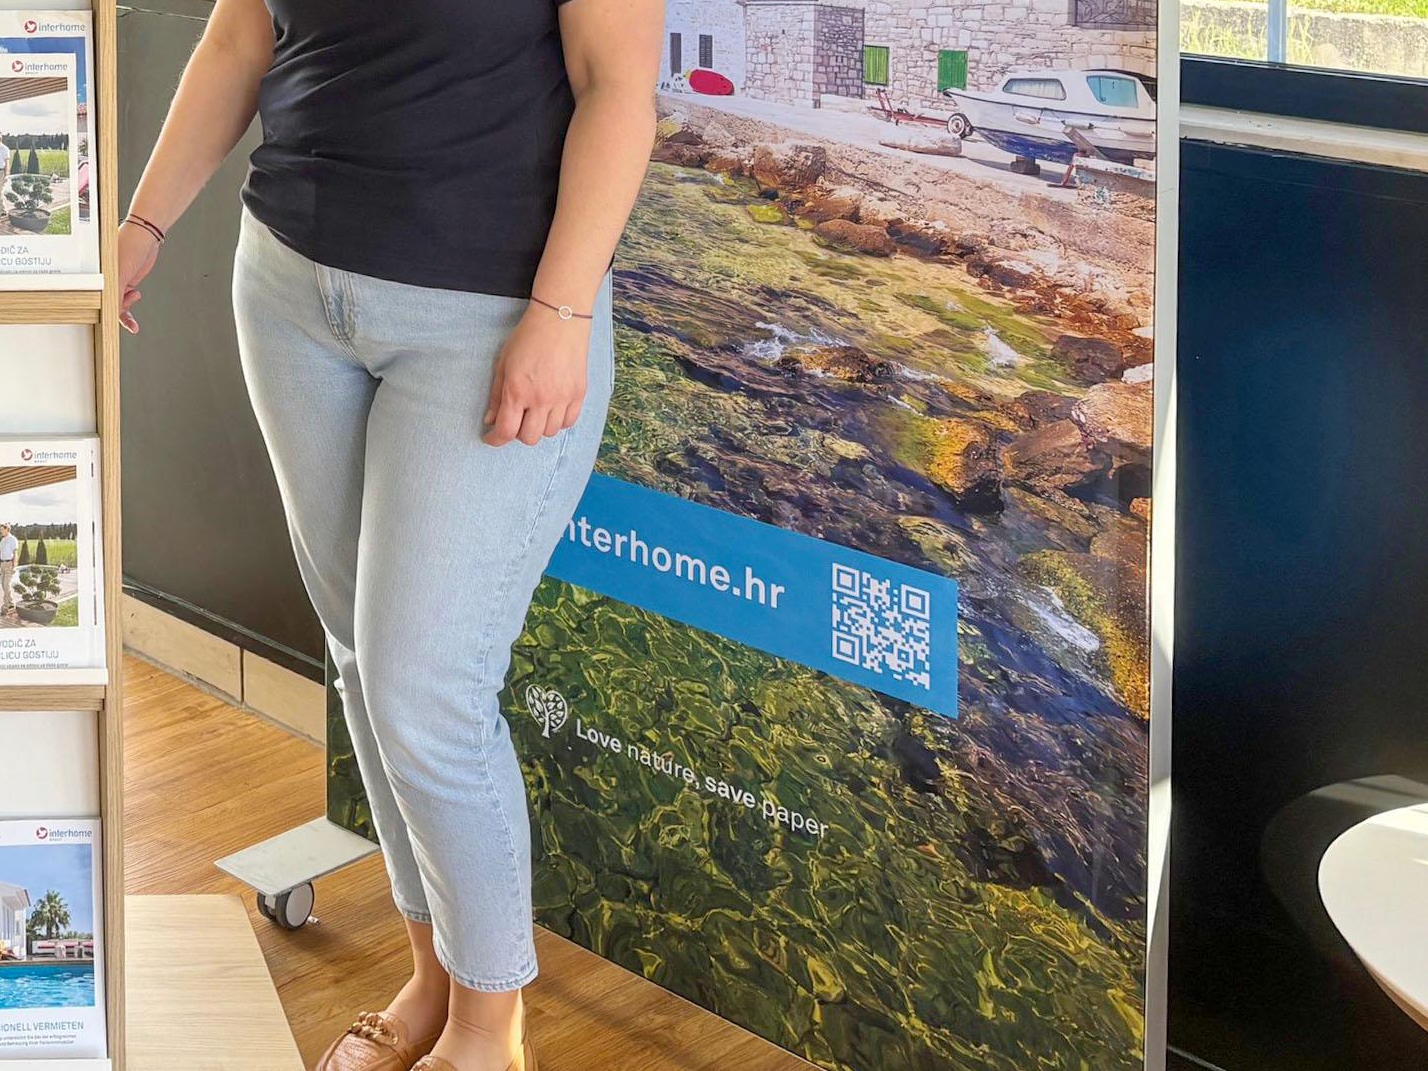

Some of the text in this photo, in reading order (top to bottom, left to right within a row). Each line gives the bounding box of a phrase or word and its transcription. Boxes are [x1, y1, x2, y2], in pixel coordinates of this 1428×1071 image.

[38, 22, 86, 32] interhome
[25, 62, 68, 72] interhome
[17, 245, 29, 254] ZA
[15, 257, 52, 266] GOSTIJU
[33, 450, 77, 460] interhome
[563, 516, 786, 609] nterhome.hr
[24, 639, 36, 648] ZA
[23, 650, 59, 660] GOSTIJU
[576, 718, 829, 838] Love nature, save paper
[49, 828, 93, 838] interhome
[33, 1020, 84, 1031] VERMIETEN
